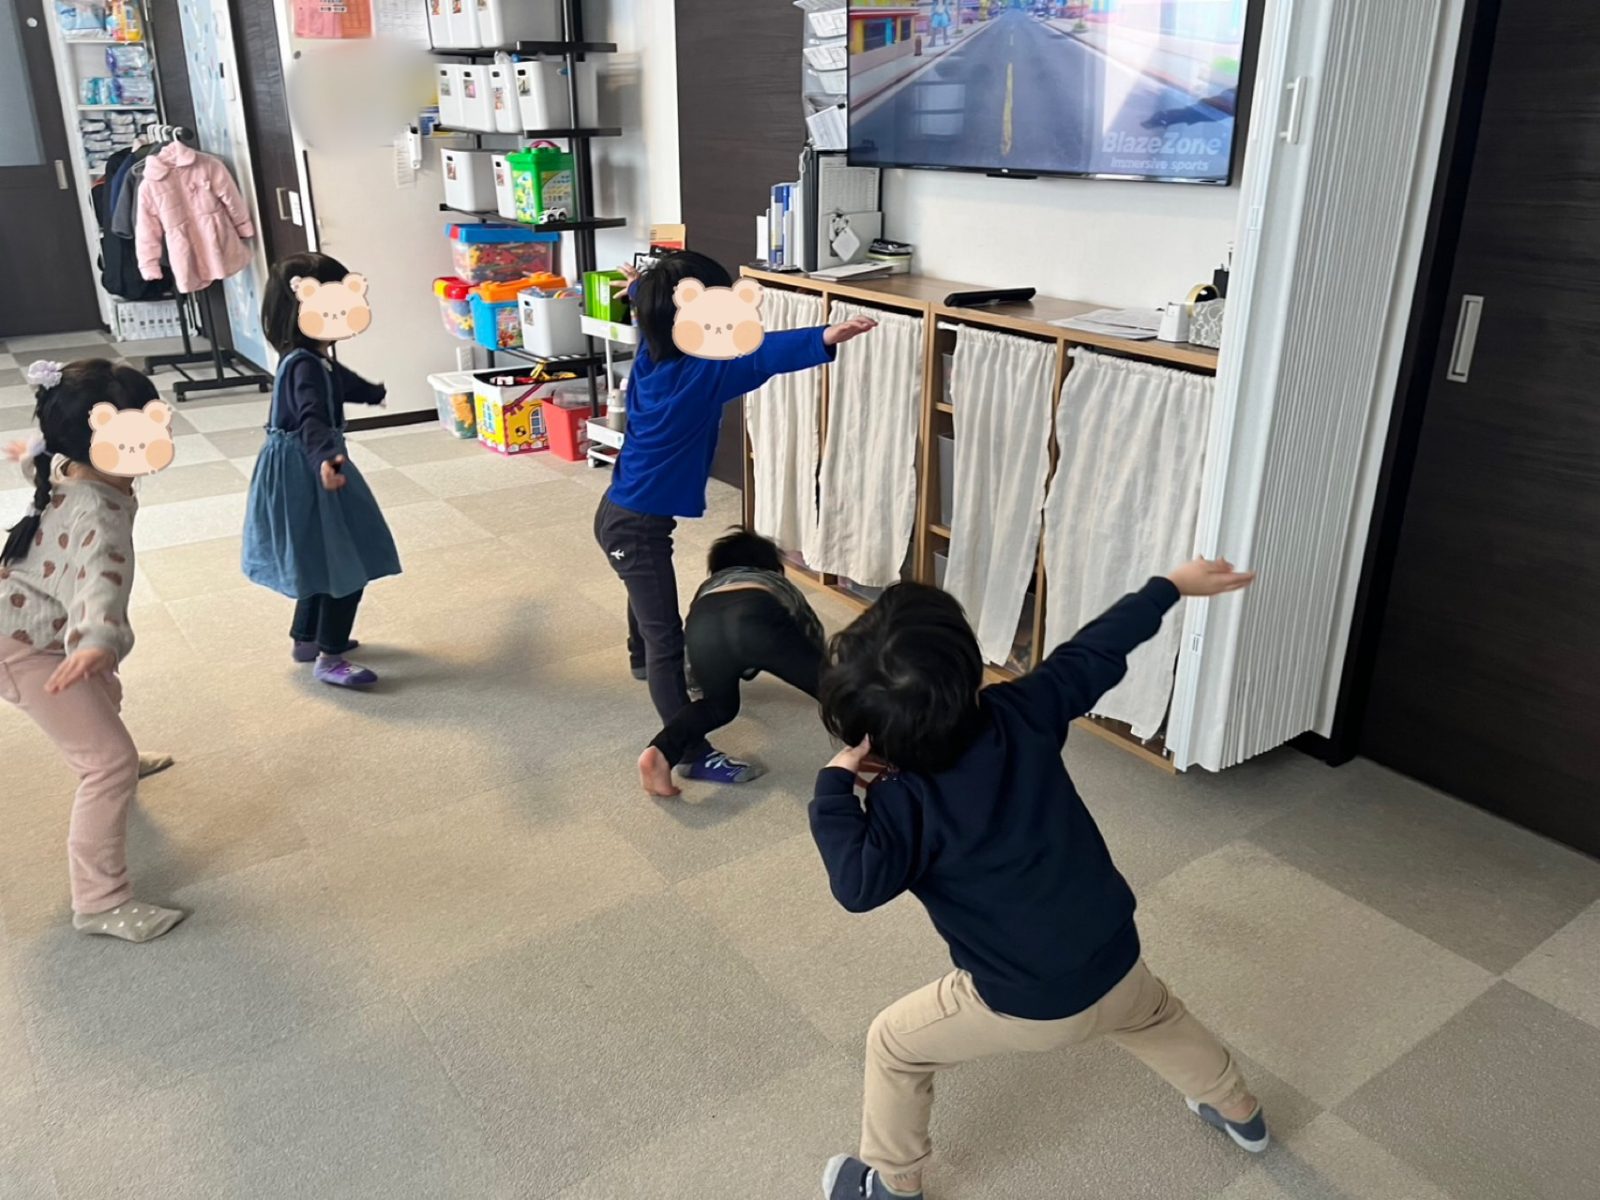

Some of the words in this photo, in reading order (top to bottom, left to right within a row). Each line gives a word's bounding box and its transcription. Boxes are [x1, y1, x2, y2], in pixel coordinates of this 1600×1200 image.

[1102, 131, 1221, 155] BlazeZone
[1110, 156, 1168, 170] Immersive
[1170, 159, 1209, 172] sports
